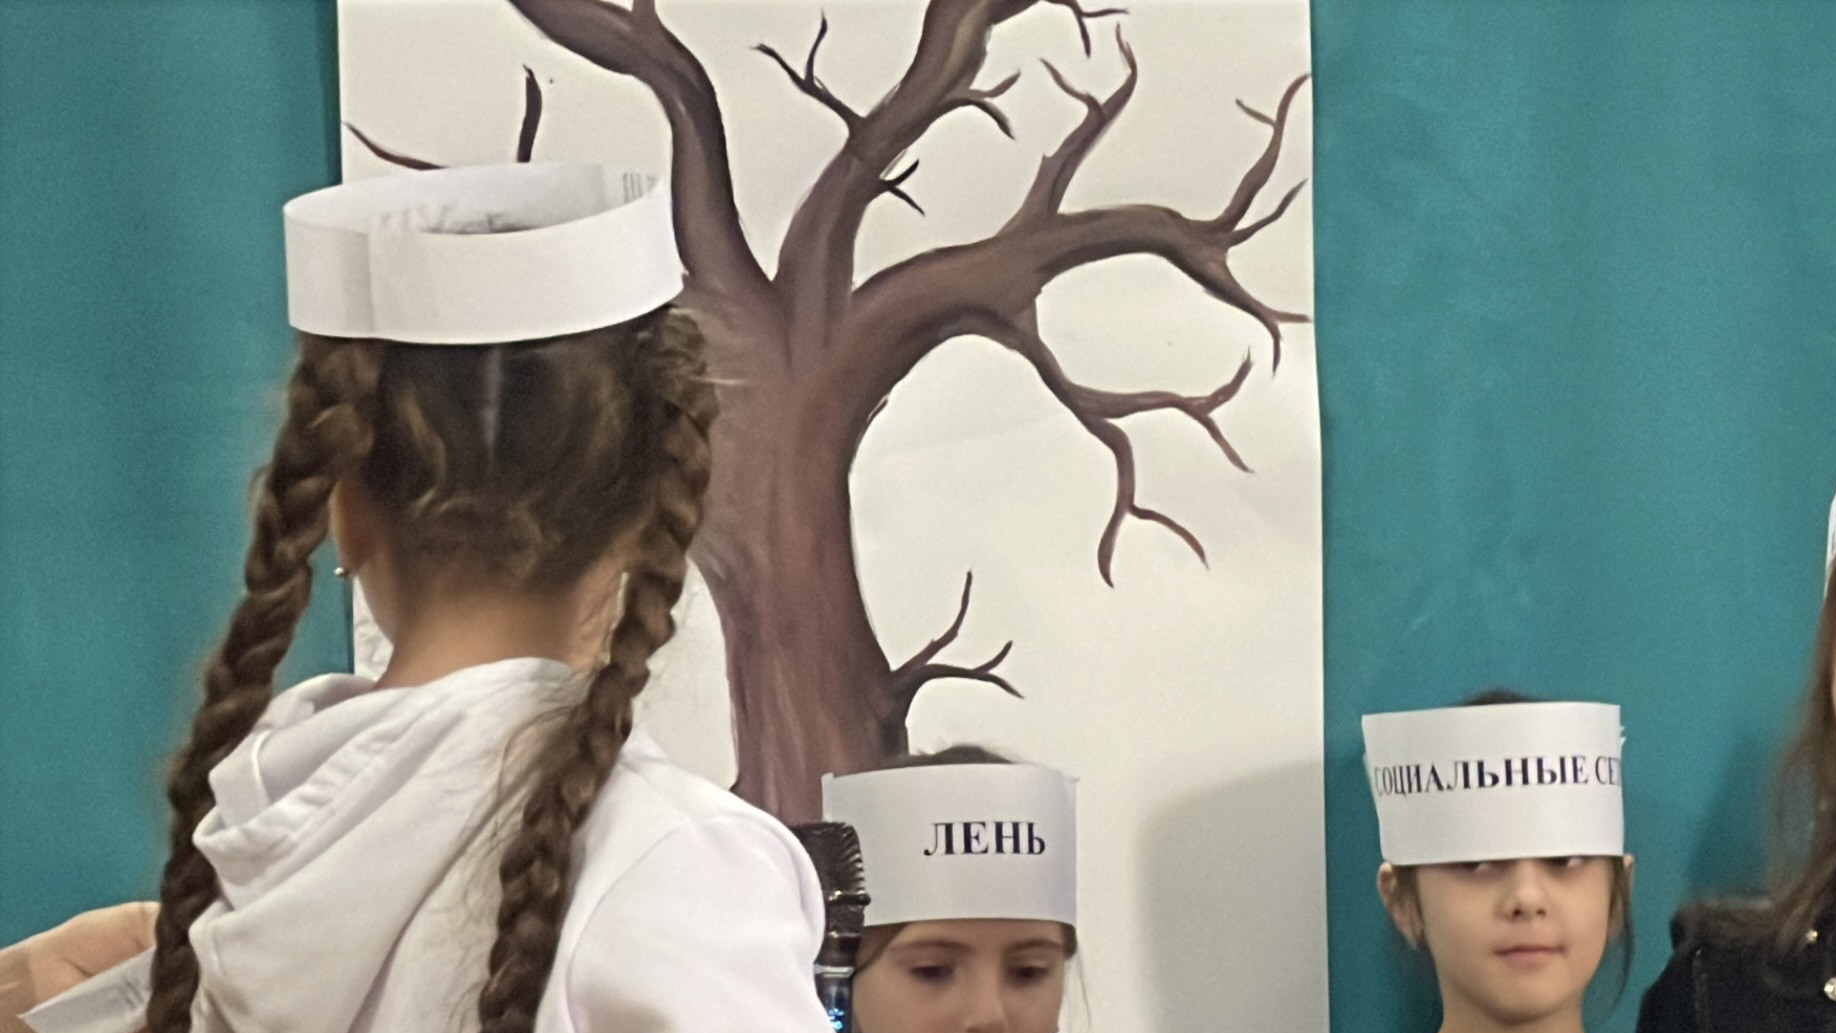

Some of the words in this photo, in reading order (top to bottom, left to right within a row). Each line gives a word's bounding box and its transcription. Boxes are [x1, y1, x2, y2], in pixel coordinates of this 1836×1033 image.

[1374, 755, 1588, 798] СОЦИАЛЬНЫЕ
[1595, 755, 1622, 786] СЕ
[923, 820, 1047, 857] ЛЕНЬ
